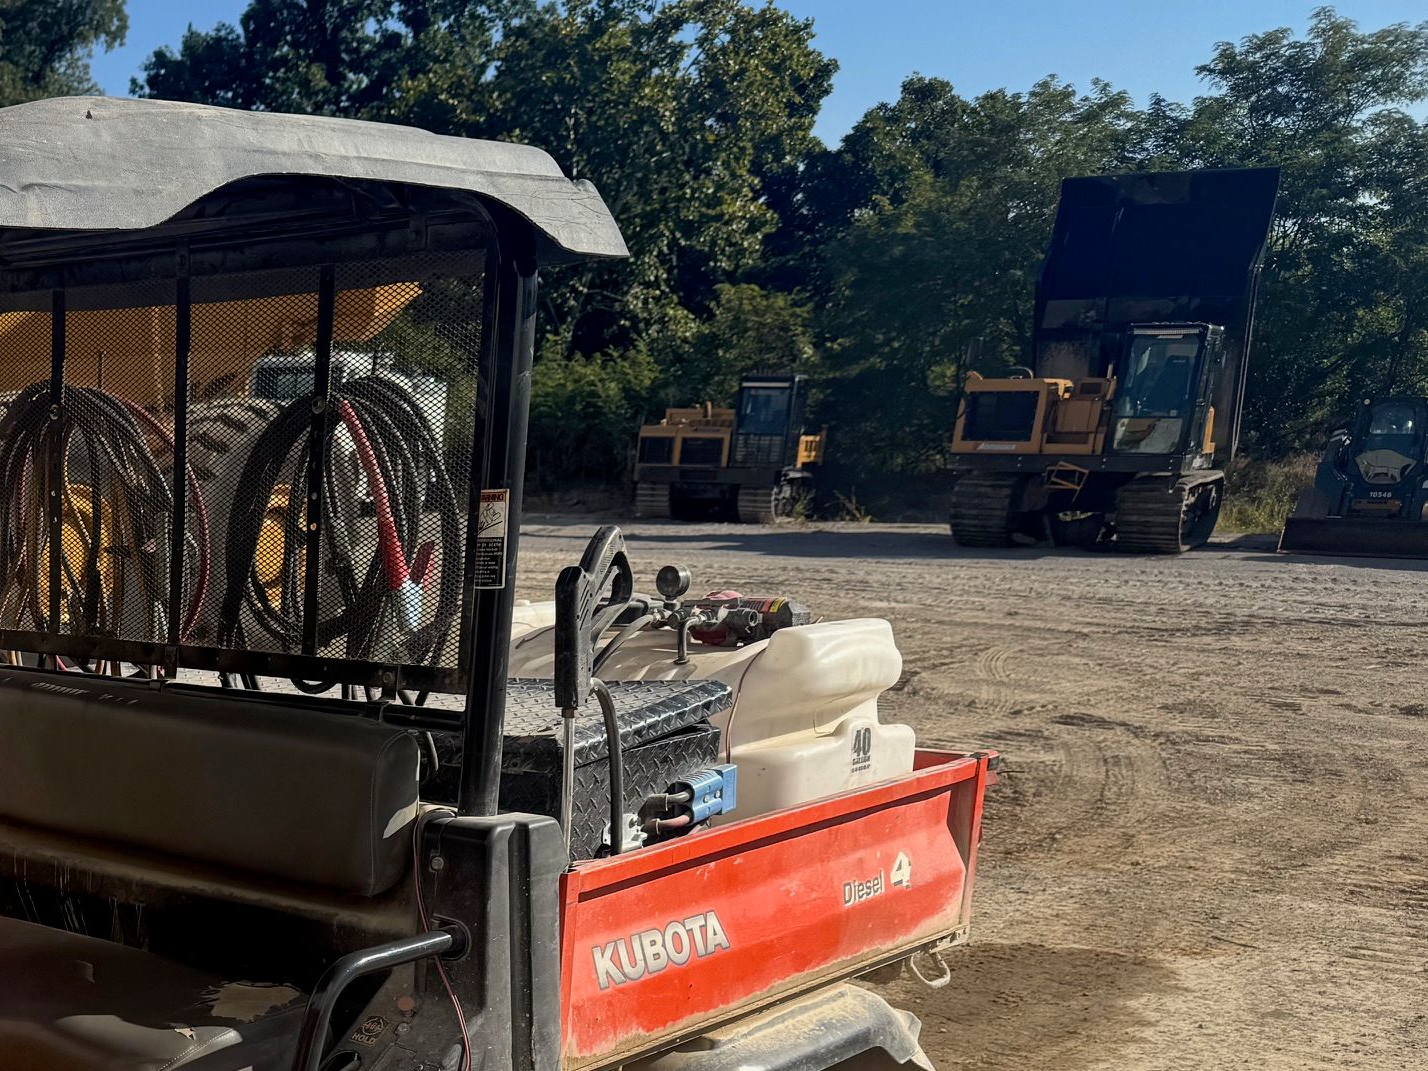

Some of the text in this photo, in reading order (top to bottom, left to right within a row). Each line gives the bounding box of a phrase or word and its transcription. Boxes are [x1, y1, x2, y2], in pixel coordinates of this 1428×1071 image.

[852, 727, 872, 757] 40
[843, 851, 912, 907] Diesel 4
[591, 910, 730, 990] KUBOTA
